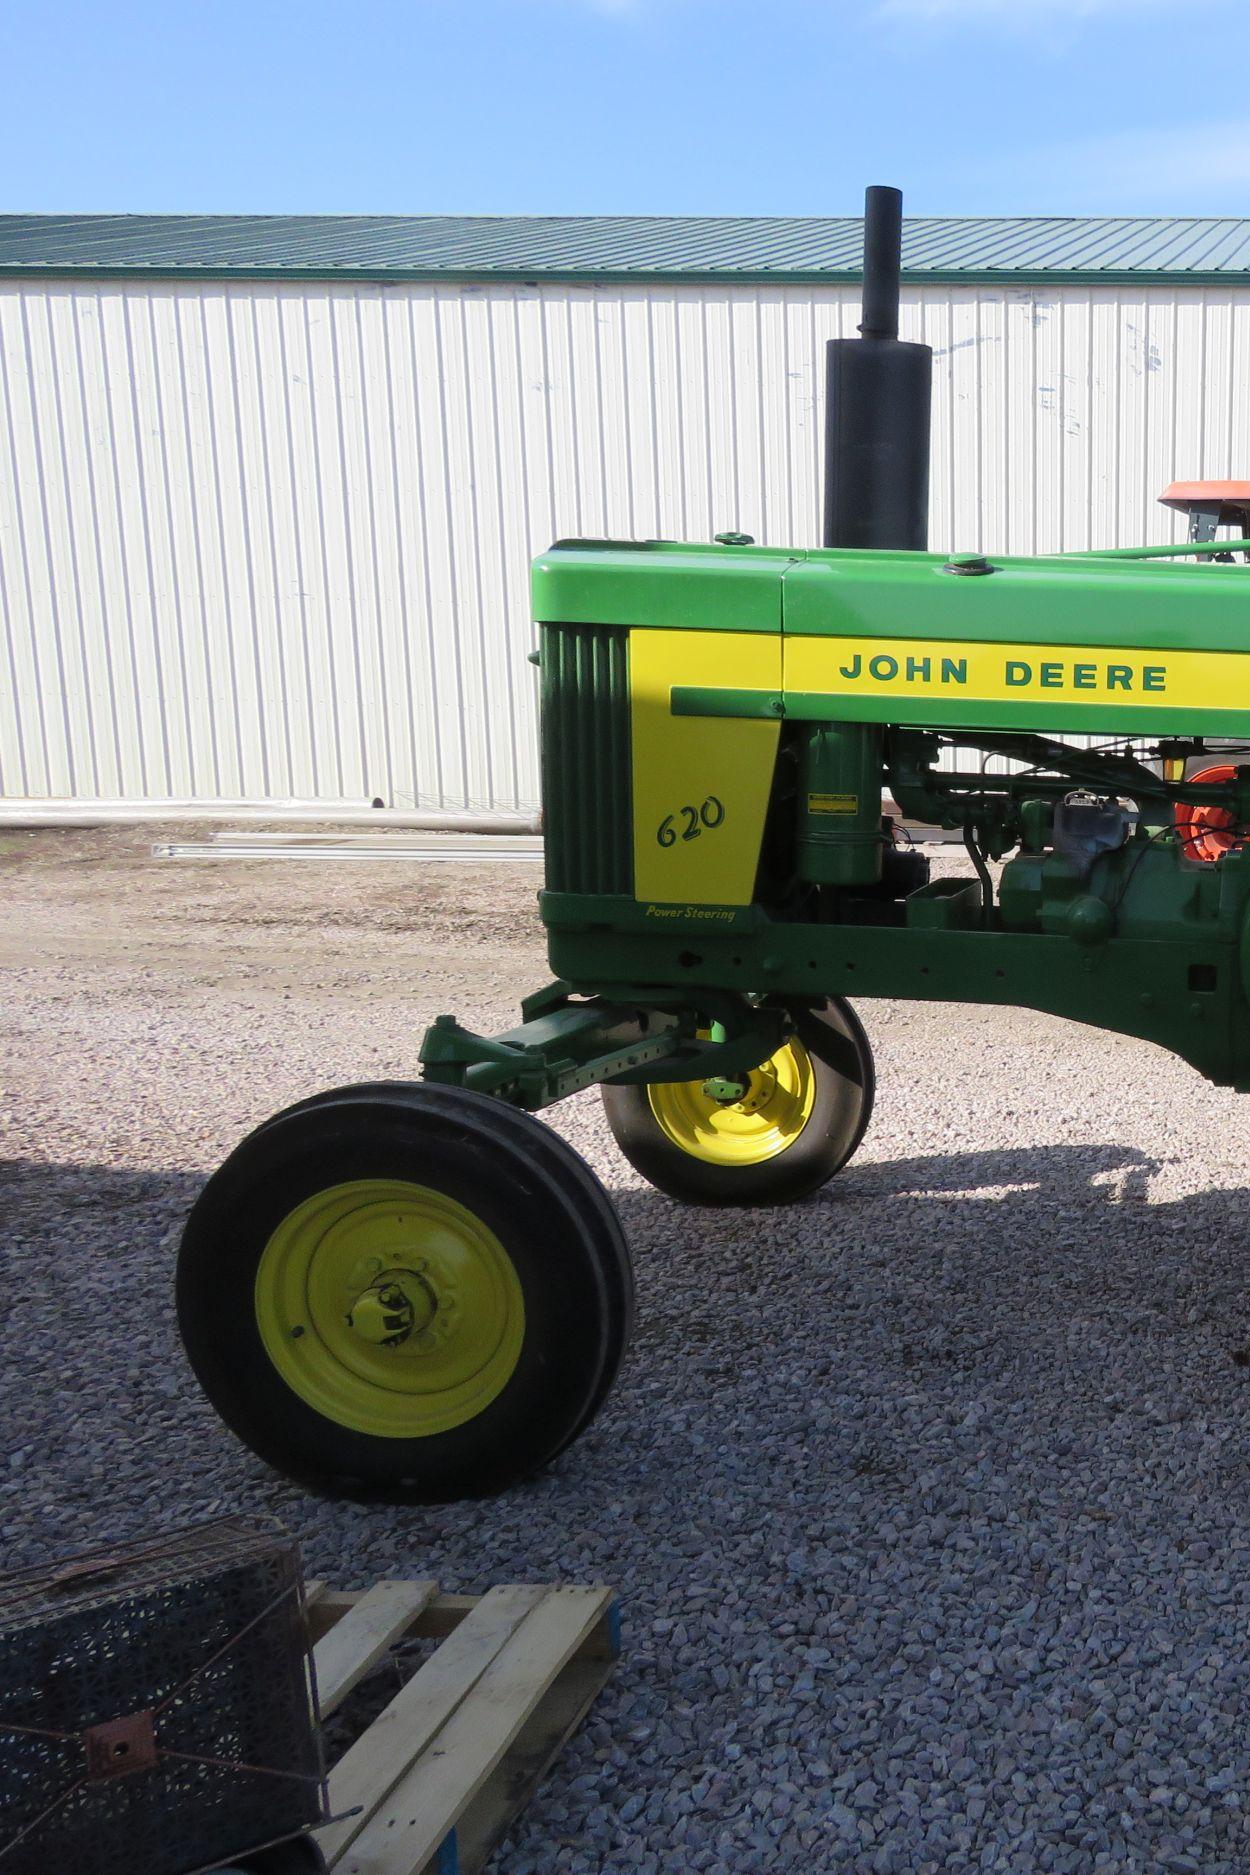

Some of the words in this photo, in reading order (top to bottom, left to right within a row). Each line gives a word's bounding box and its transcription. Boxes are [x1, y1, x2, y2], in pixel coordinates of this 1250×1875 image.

[839, 654, 968, 684] JOHN
[1005, 660, 1167, 692] DEERE
[656, 795, 725, 848] 620
[646, 904, 683, 918] Power
[684, 905, 736, 922] Steering
